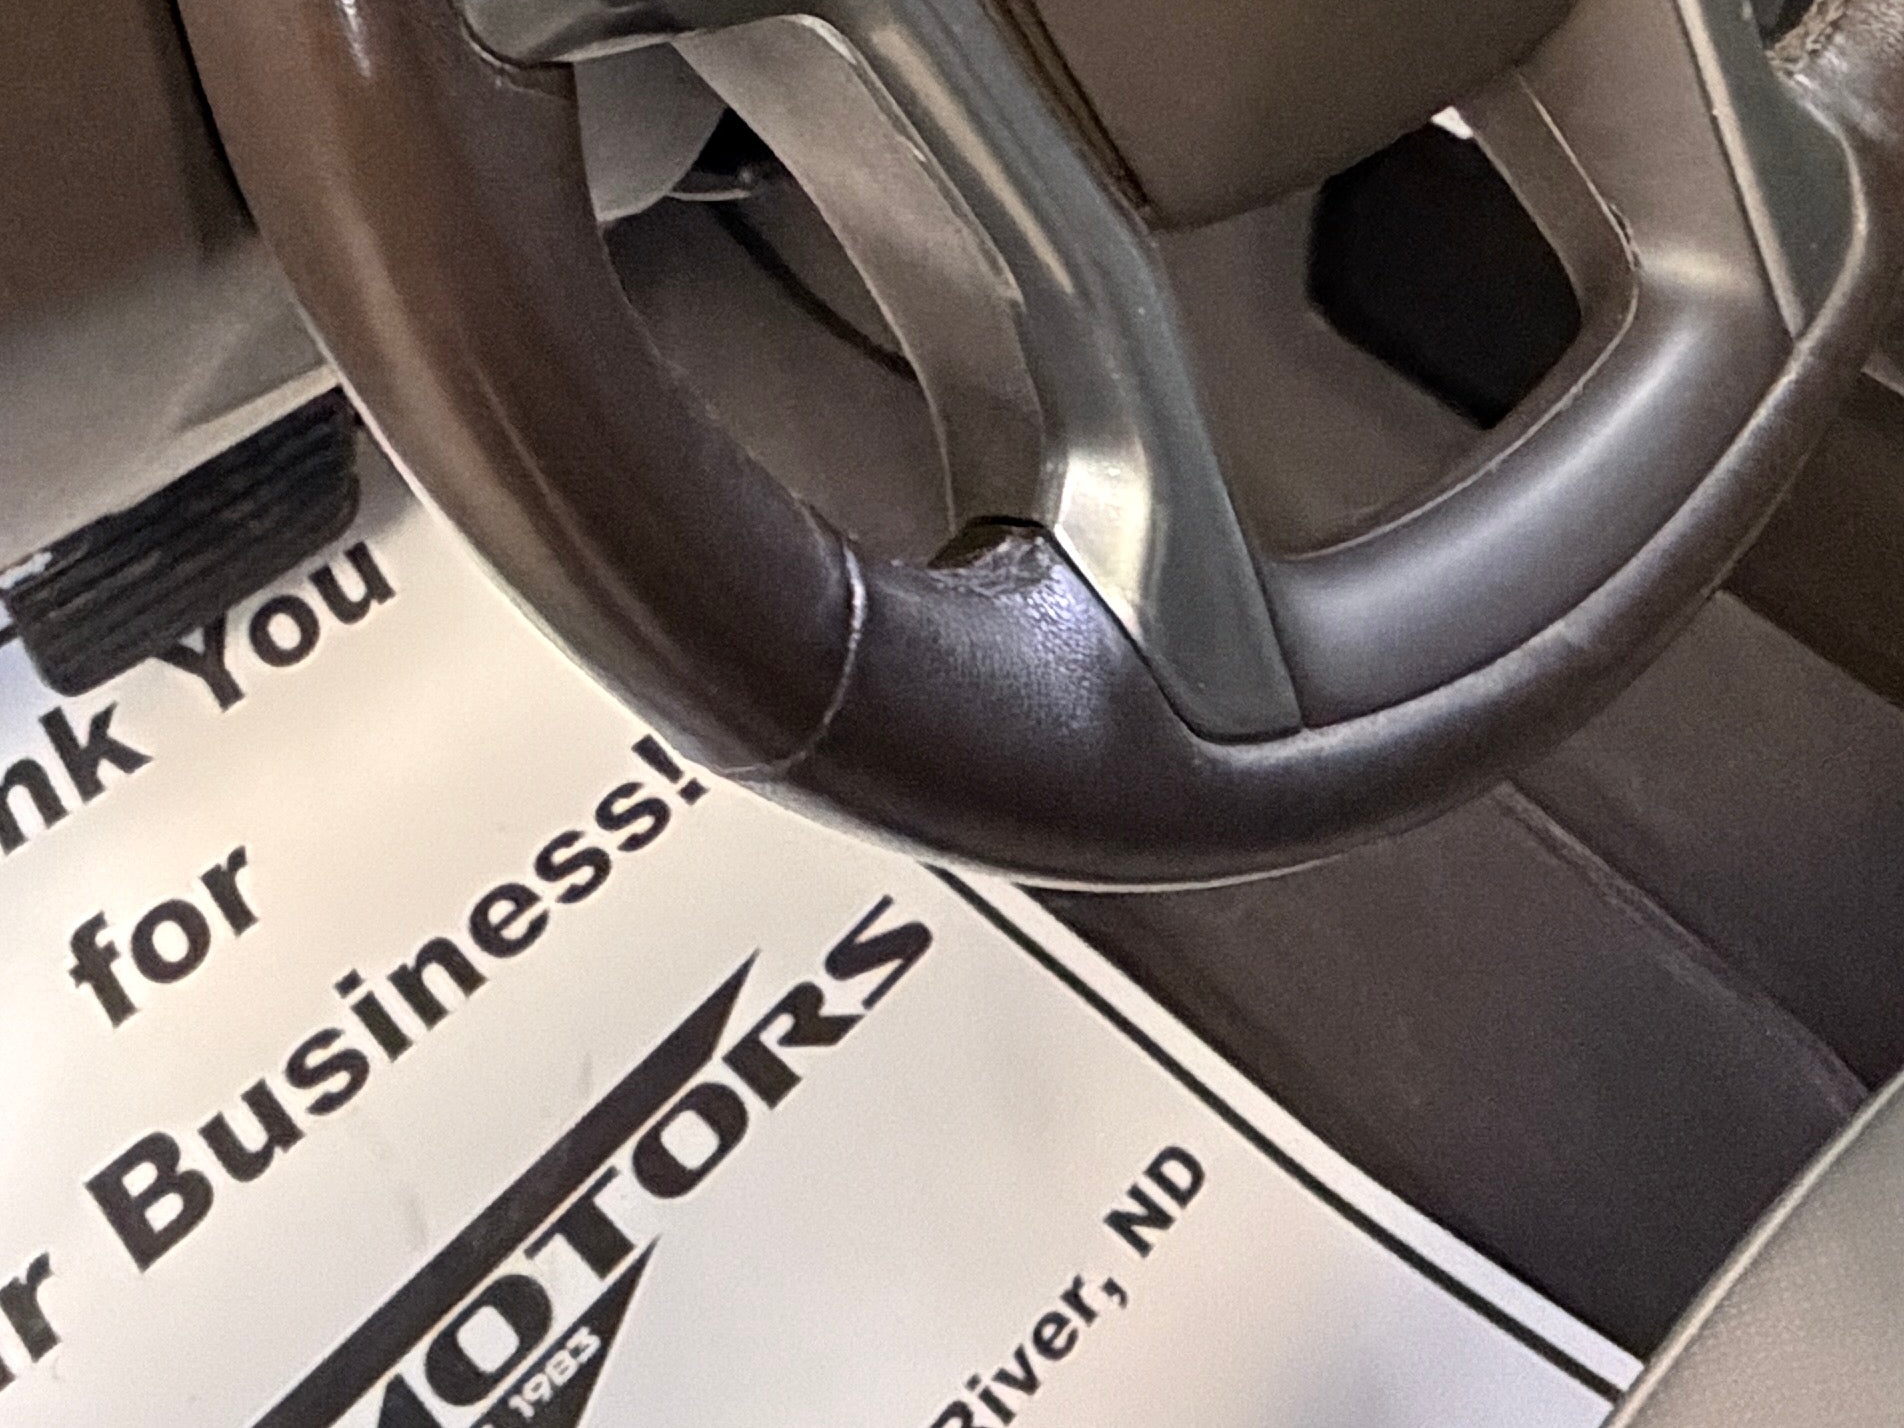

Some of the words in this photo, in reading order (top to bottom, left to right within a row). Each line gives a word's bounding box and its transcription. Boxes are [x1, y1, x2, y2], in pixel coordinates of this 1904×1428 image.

[148, 541, 397, 713] You
[65, 845, 265, 1031] for
[84, 733, 712, 1276] Business!
[1102, 1145, 1206, 1259] ND
[507, 1325, 602, 1422] 1983
